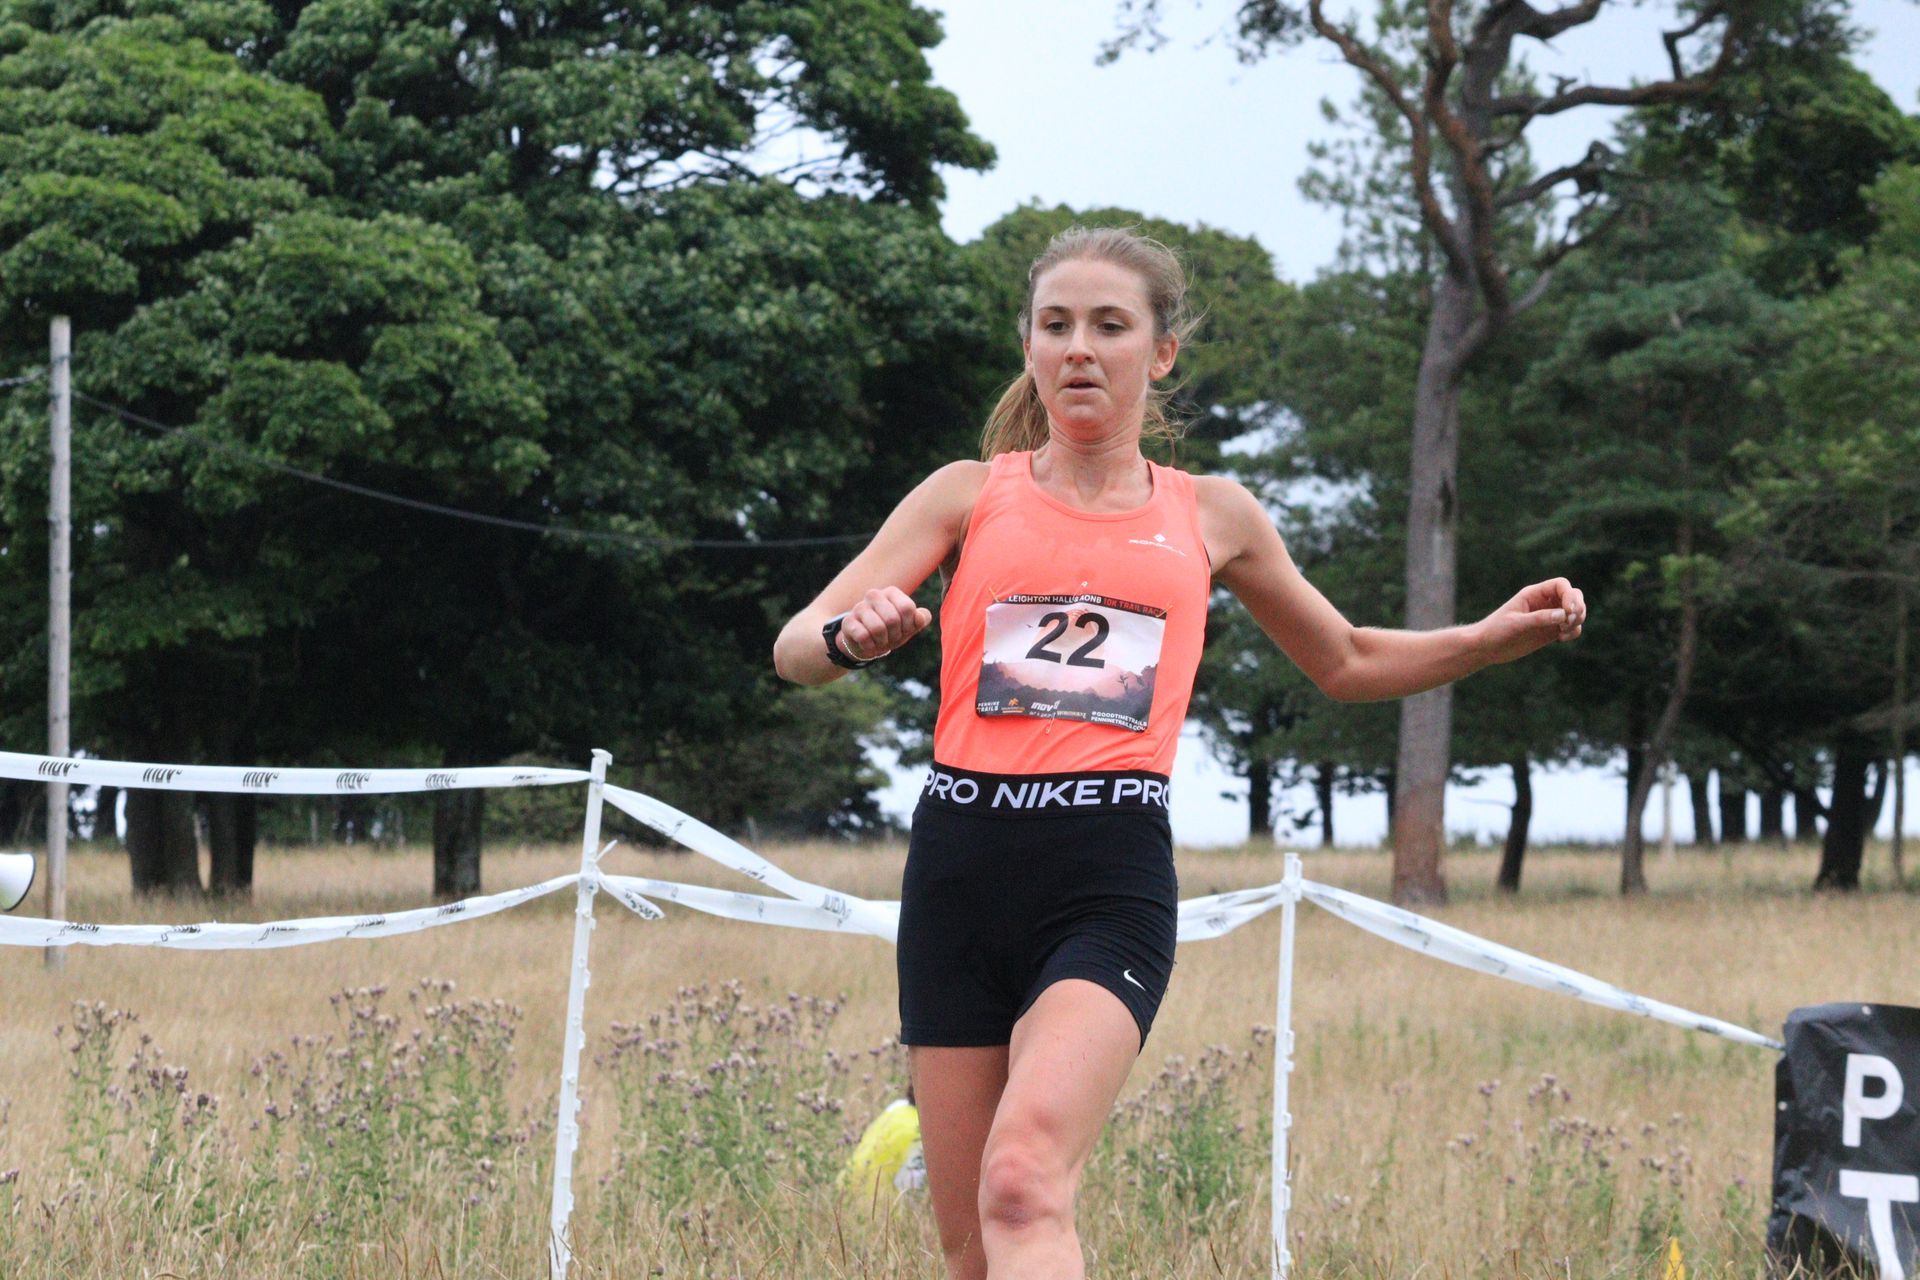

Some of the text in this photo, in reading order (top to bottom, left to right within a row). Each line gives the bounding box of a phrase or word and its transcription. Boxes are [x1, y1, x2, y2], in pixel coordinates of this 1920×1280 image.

[1008, 595, 1051, 603] LEIGHTON
[1052, 596, 1072, 604] HALL
[1079, 594, 1102, 604] AONB
[1103, 598, 1117, 608] 10K
[1119, 600, 1140, 612] TRAIL
[1026, 612, 1110, 669] 22
[991, 778, 1106, 809] NIKE
[1842, 1053, 1904, 1147] P
[1838, 1169, 1919, 1280] T
